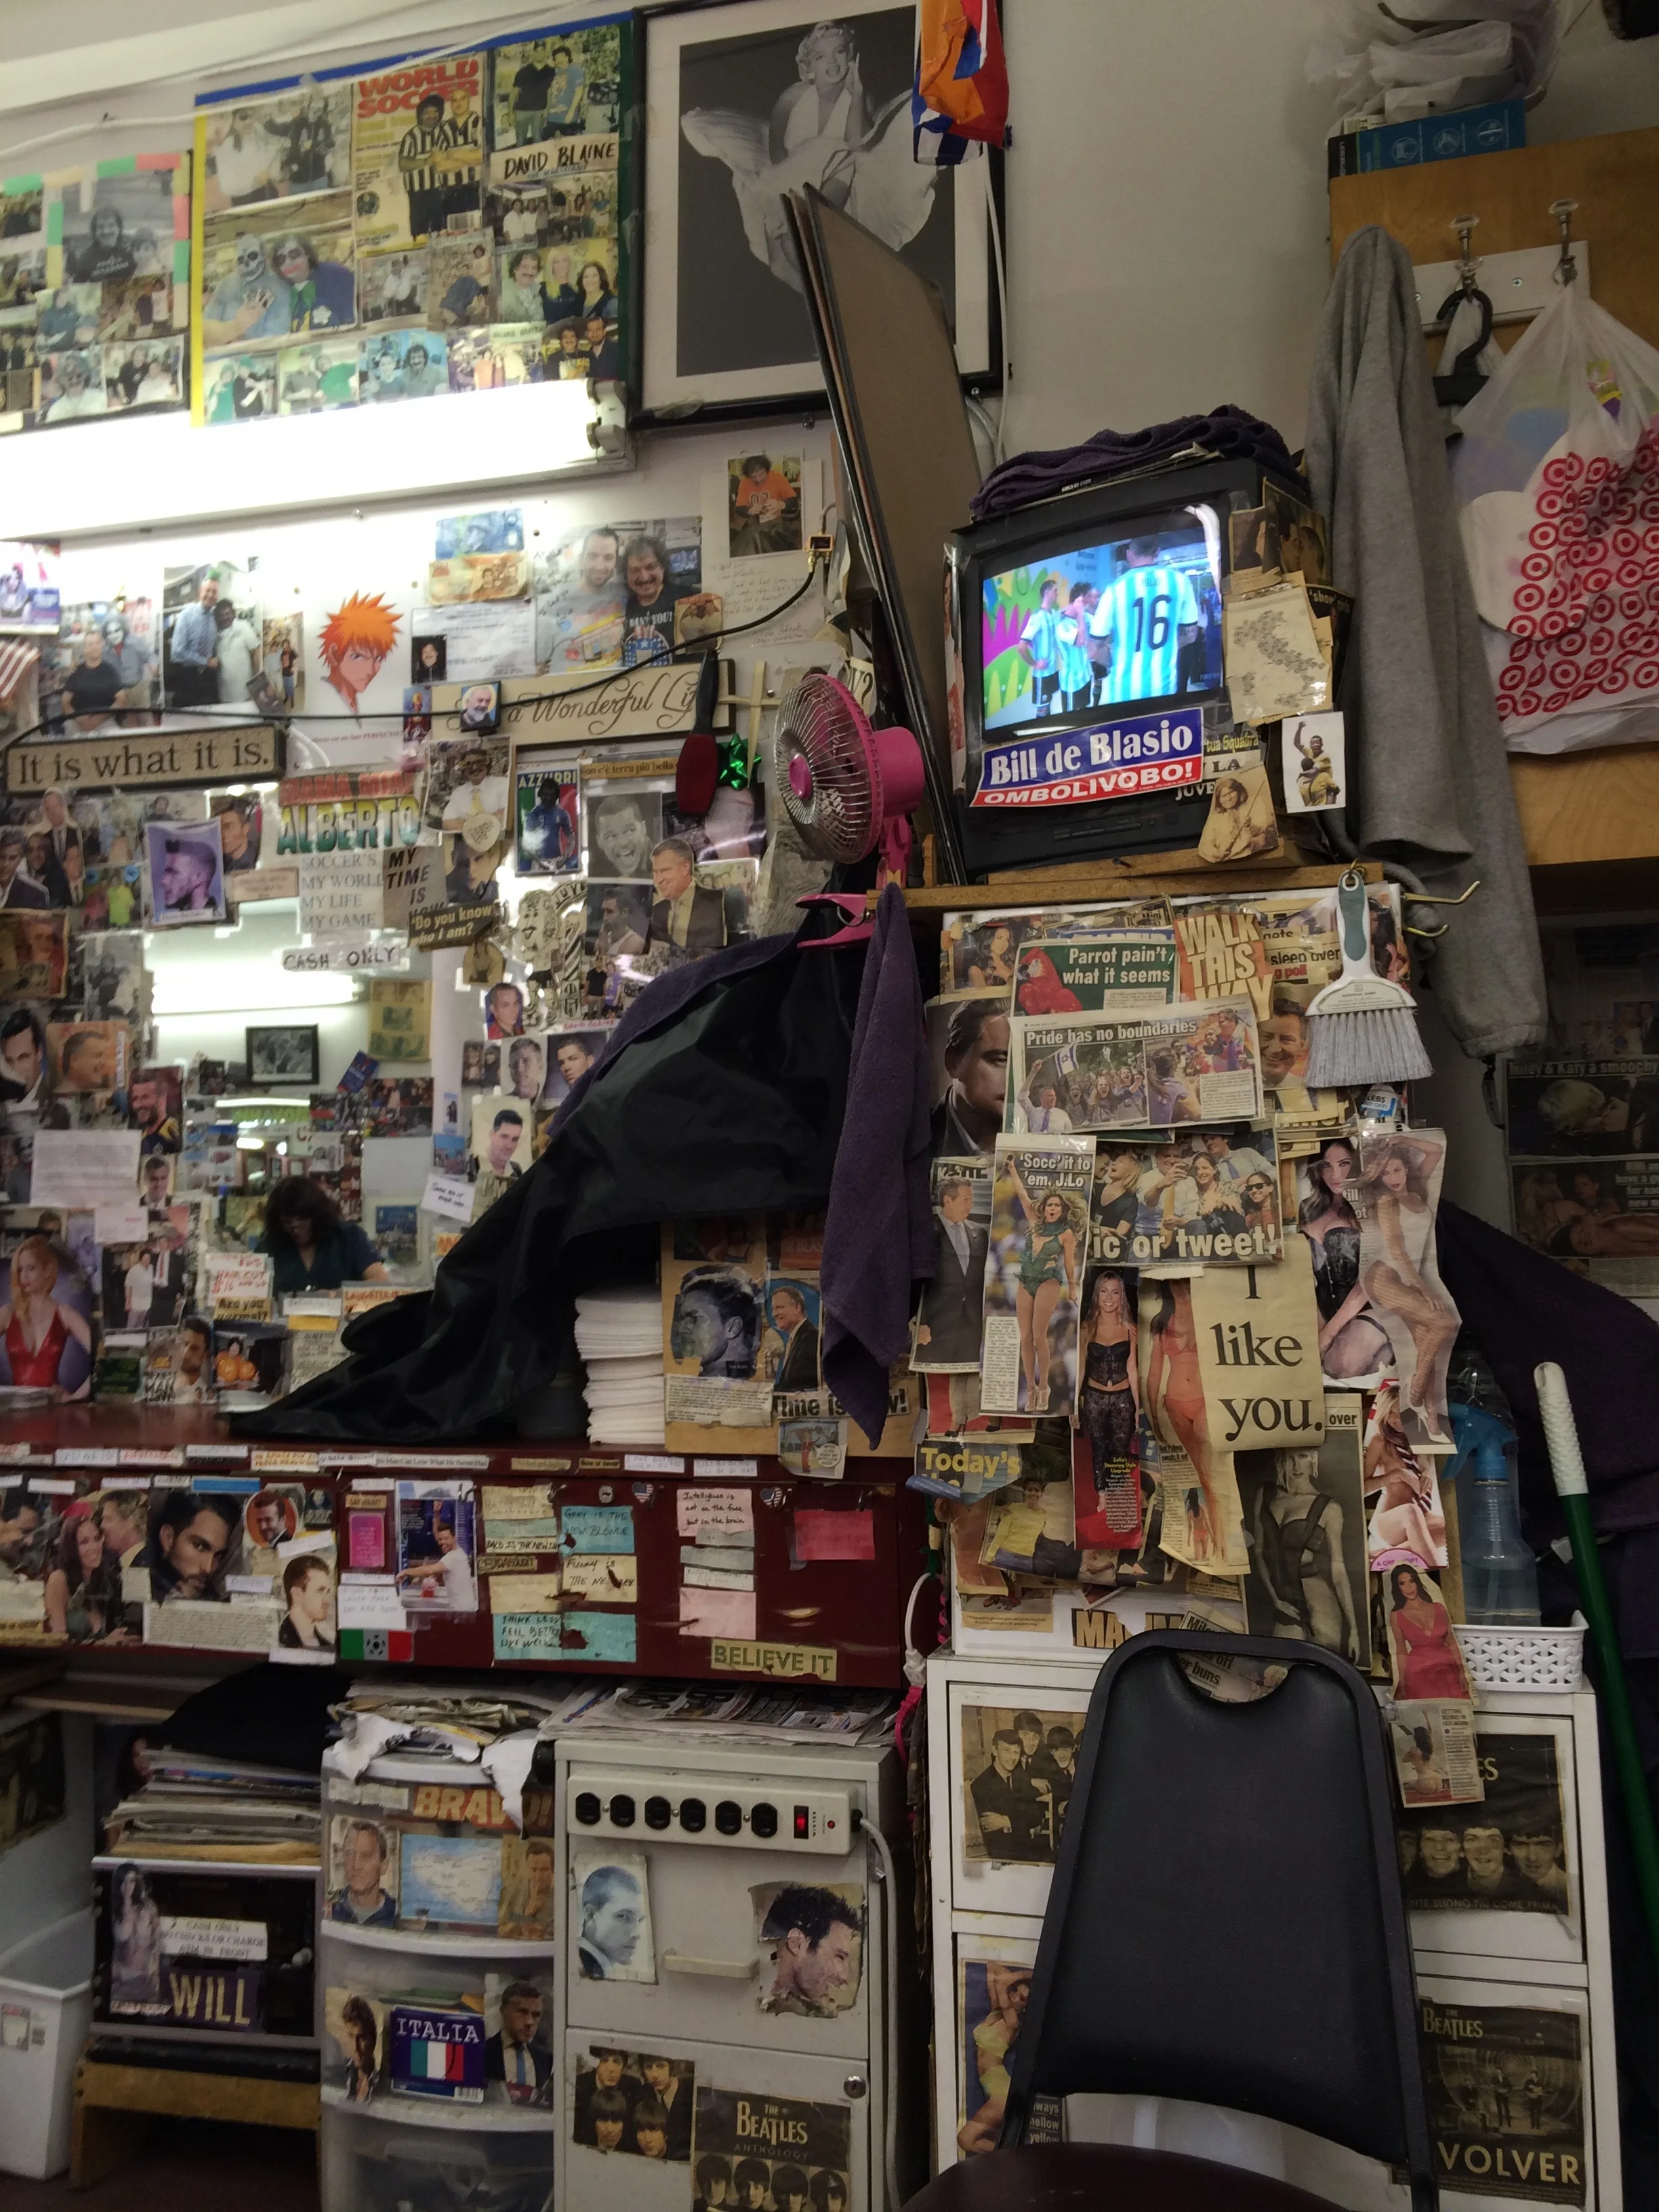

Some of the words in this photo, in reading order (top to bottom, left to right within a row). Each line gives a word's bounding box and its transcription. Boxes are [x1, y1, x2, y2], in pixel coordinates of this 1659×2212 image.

[359, 59, 480, 98] WORLD
[504, 152, 548, 179] DAVID
[557, 142, 617, 166] BLAINE
[1132, 594, 1171, 652] 16
[508, 705, 525, 723] a
[518, 671, 663, 735] Wonderful
[19, 754, 42, 785] It
[54, 751, 82, 781] is
[94, 743, 181, 780] what
[194, 739, 220, 771] it
[233, 737, 270, 769] is.
[989, 747, 1038, 785] Bill
[1045, 743, 1082, 775] de
[1090, 719, 1193, 766] Blasio
[518, 771, 577, 788] AZZRRI
[983, 761, 1193, 804] OMBOLIVOBO!
[278, 796, 421, 855] ALBERTO
[302, 853, 377, 870] SOCCER'S
[388, 847, 417, 869] MY
[387, 865, 431, 890] TIME
[330, 893, 363, 908] LIFE
[409, 886, 426, 906] IS
[329, 913, 376, 929] GAME
[434, 912, 456, 929] you
[459, 905, 492, 920] know
[447, 922, 474, 939] am?
[1176, 914, 1260, 956] WALK
[283, 952, 330, 970] CASH
[346, 947, 397, 968] ONLY
[1069, 947, 1118, 965] Parrot
[1122, 946, 1168, 966] pain't
[1187, 943, 1256, 989] THIS
[1062, 968, 1100, 985] what
[1105, 967, 1115, 985] it
[1120, 968, 1171, 985] seems
[1026, 1029, 1064, 1046] Pride
[1067, 1026, 1092, 1043] has
[1096, 1029, 1114, 1041] no
[1118, 1019, 1197, 1040] boundaries
[1019, 1153, 1061, 1170] 'Socc'
[1065, 1153, 1074, 1168] it
[1077, 1155, 1090, 1170] to
[1055, 1172, 1084, 1187] J.Lo
[1343, 1189, 1359, 1201] till
[1355, 1207, 1367, 1219] ot
[1087, 1233, 1120, 1258] ic
[1133, 1233, 1166, 1258] or
[1175, 1222, 1279, 1258] tweet!
[1245, 1265, 1263, 1300] I
[218, 1297, 241, 1310] Are
[243, 1298, 266, 1311] you
[1209, 1321, 1303, 1368] like
[1218, 1394, 1324, 1441] you.
[1328, 1413, 1358, 1426] over
[920, 1446, 1021, 1479] Today's
[714, 1644, 804, 1672] BELIEVE
[811, 1654, 834, 1675] IT
[1215, 1656, 1236, 1669] off
[1192, 1662, 1222, 1685] buns
[169, 1971, 251, 2026] WILL
[396, 2017, 480, 2044] ITALIA
[1422, 2006, 1484, 2041] BEATLES
[764, 2104, 779, 2116] THE
[736, 2101, 808, 2147] BEATLES
[733, 2142, 809, 2160] ANTHOLOGY
[1437, 2141, 1581, 2186] VOLVER
